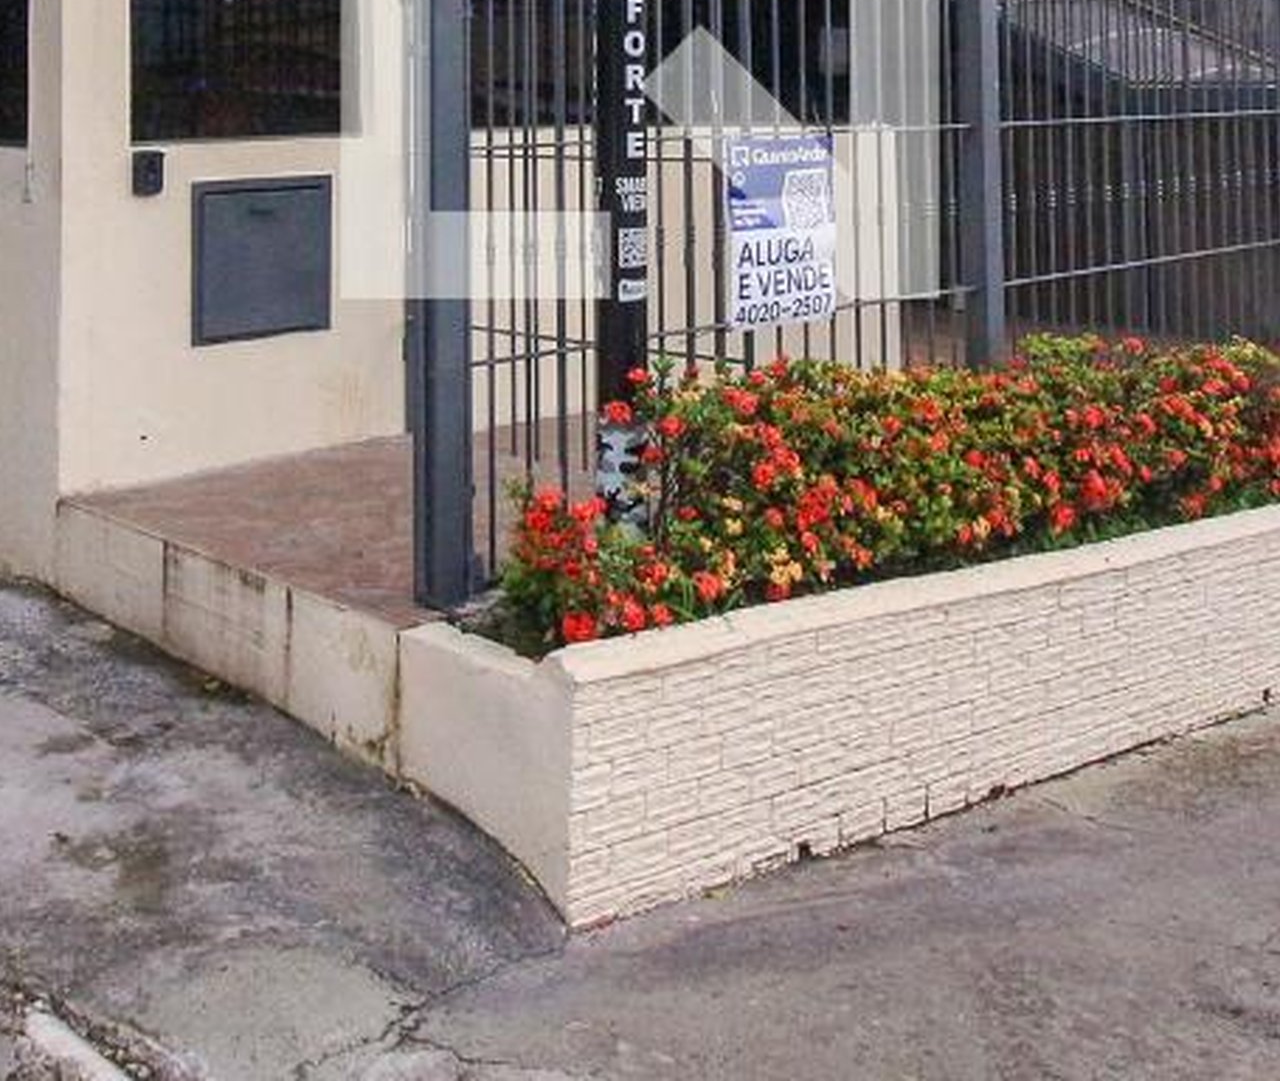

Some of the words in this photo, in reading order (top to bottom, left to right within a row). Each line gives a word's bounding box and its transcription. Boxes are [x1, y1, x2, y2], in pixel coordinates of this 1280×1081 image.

[738, 237, 814, 268] ALUGA
[738, 273, 752, 300] E
[756, 262, 830, 296] VENDE
[734, 293, 832, 324] 4020-2507
